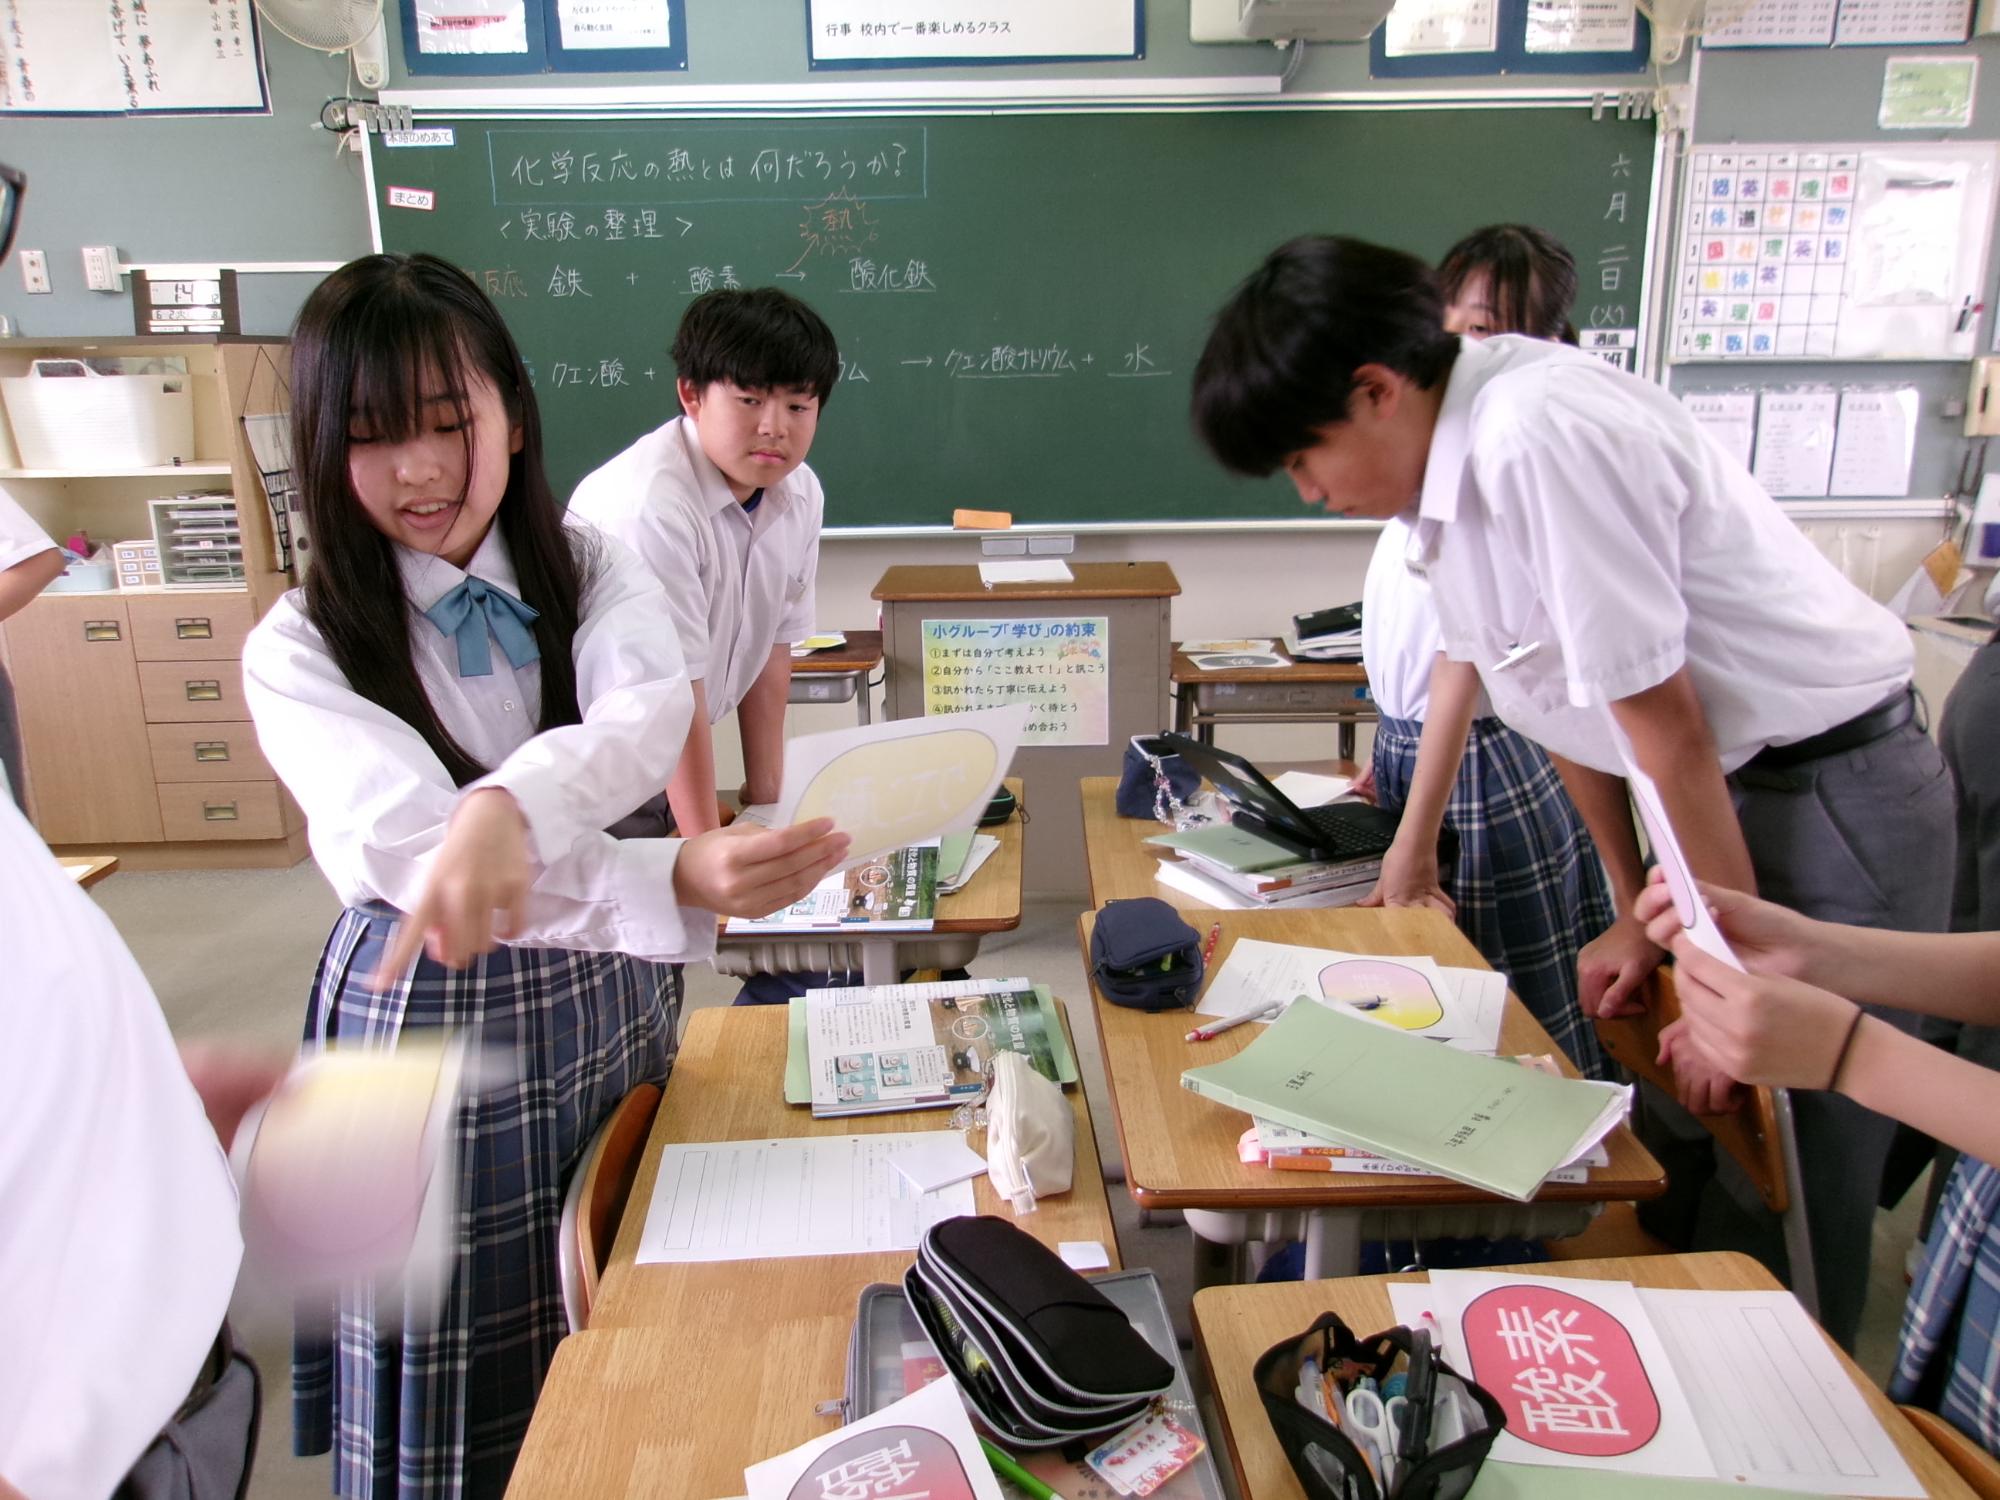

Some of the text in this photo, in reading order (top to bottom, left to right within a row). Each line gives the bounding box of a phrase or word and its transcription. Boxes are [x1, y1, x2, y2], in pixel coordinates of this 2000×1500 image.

[825, 21, 1012, 37] 行事 校内で一番楽しめるクラス
[394, 192, 429, 206] まとめ
[547, 264, 593, 297] 鉄
[688, 265, 741, 294] 酸素
[848, 257, 937, 291] 酸化鉄
[552, 358, 630, 388] クエン酸
[944, 343, 1077, 376] クエン酸ナトリウム
[1124, 343, 1154, 371] 水
[932, 623, 1096, 639] 小グループ「学び」の約束
[929, 647, 1046, 659] ①まずは自分で考えよう
[931, 684, 1067, 695] ③訊かれたら丁寧に伝えよう
[1023, 722, 1068, 732] め合おう
[1496, 1305, 1630, 1437] 酸素
[815, 1438, 930, 1500] 酸
